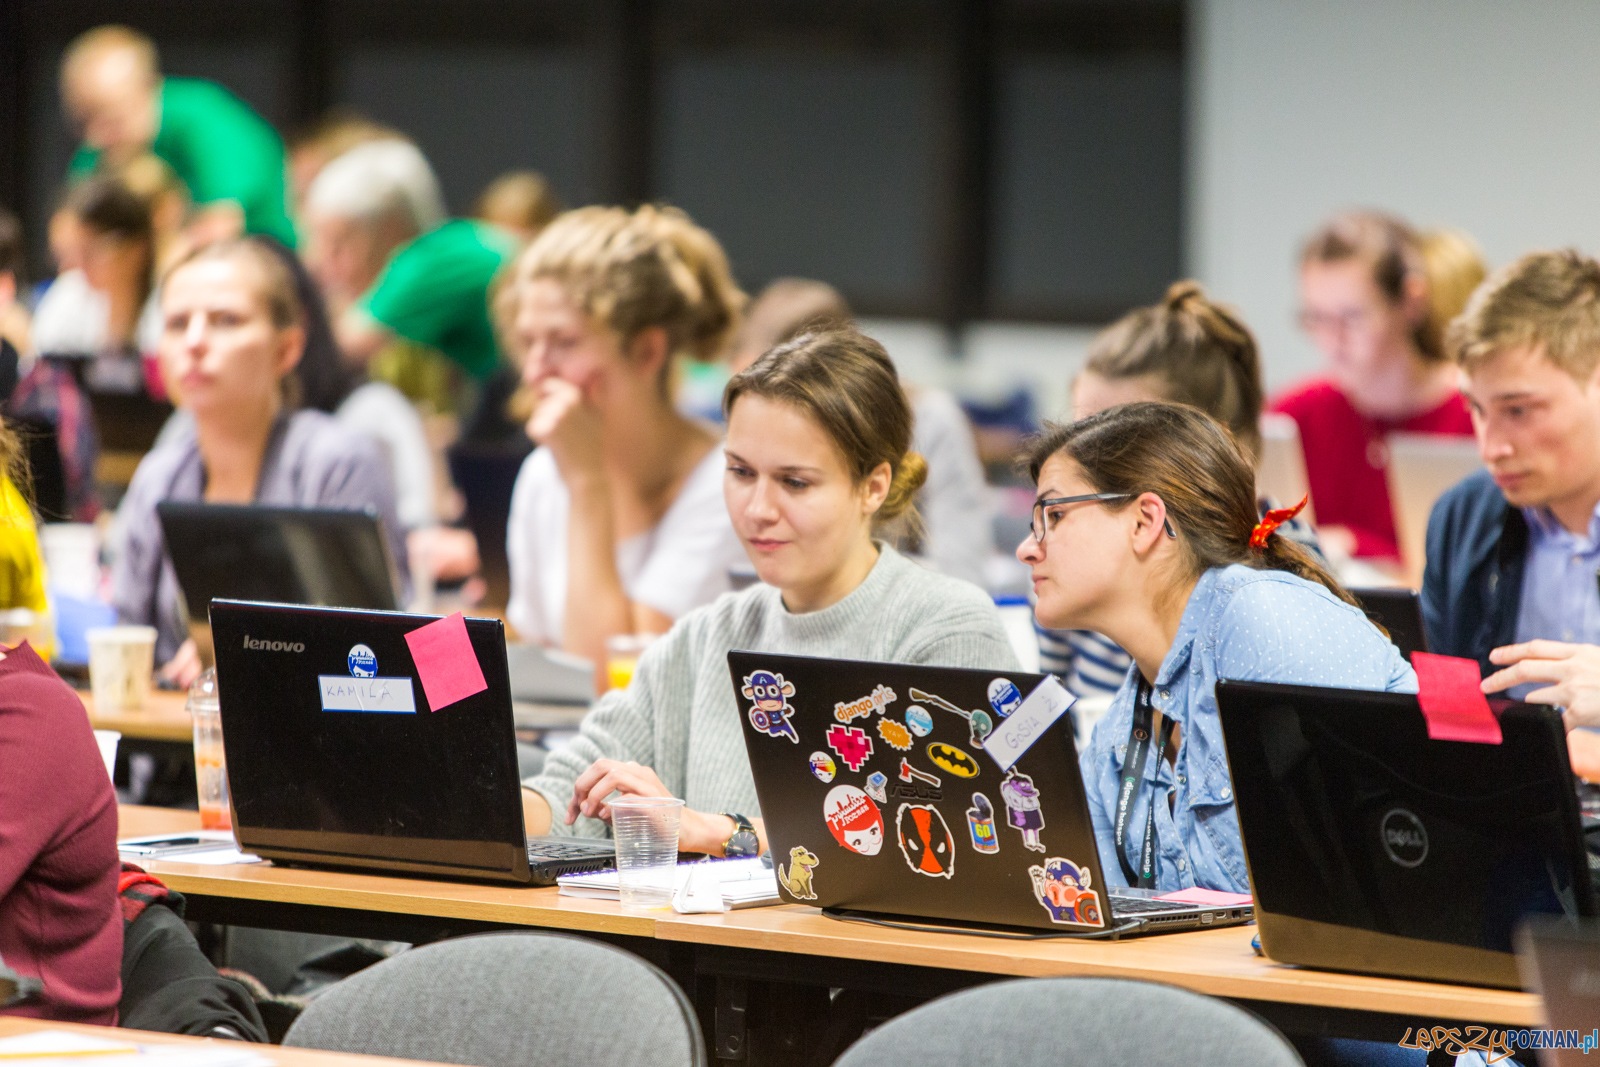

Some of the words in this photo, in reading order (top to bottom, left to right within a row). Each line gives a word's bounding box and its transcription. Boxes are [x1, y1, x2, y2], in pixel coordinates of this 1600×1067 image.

[243, 635, 305, 652] lenovo
[327, 685, 393, 700] KAMILA
[836, 699, 873, 722] django
[873, 687, 895, 713] girls
[890, 784, 943, 801] ASUS
[1120, 781, 1134, 811] django
[975, 823, 991, 838] 60
[1116, 812, 1127, 845] hotspot
[1387, 829, 1422, 847] DELL
[1143, 841, 1152, 873] django
